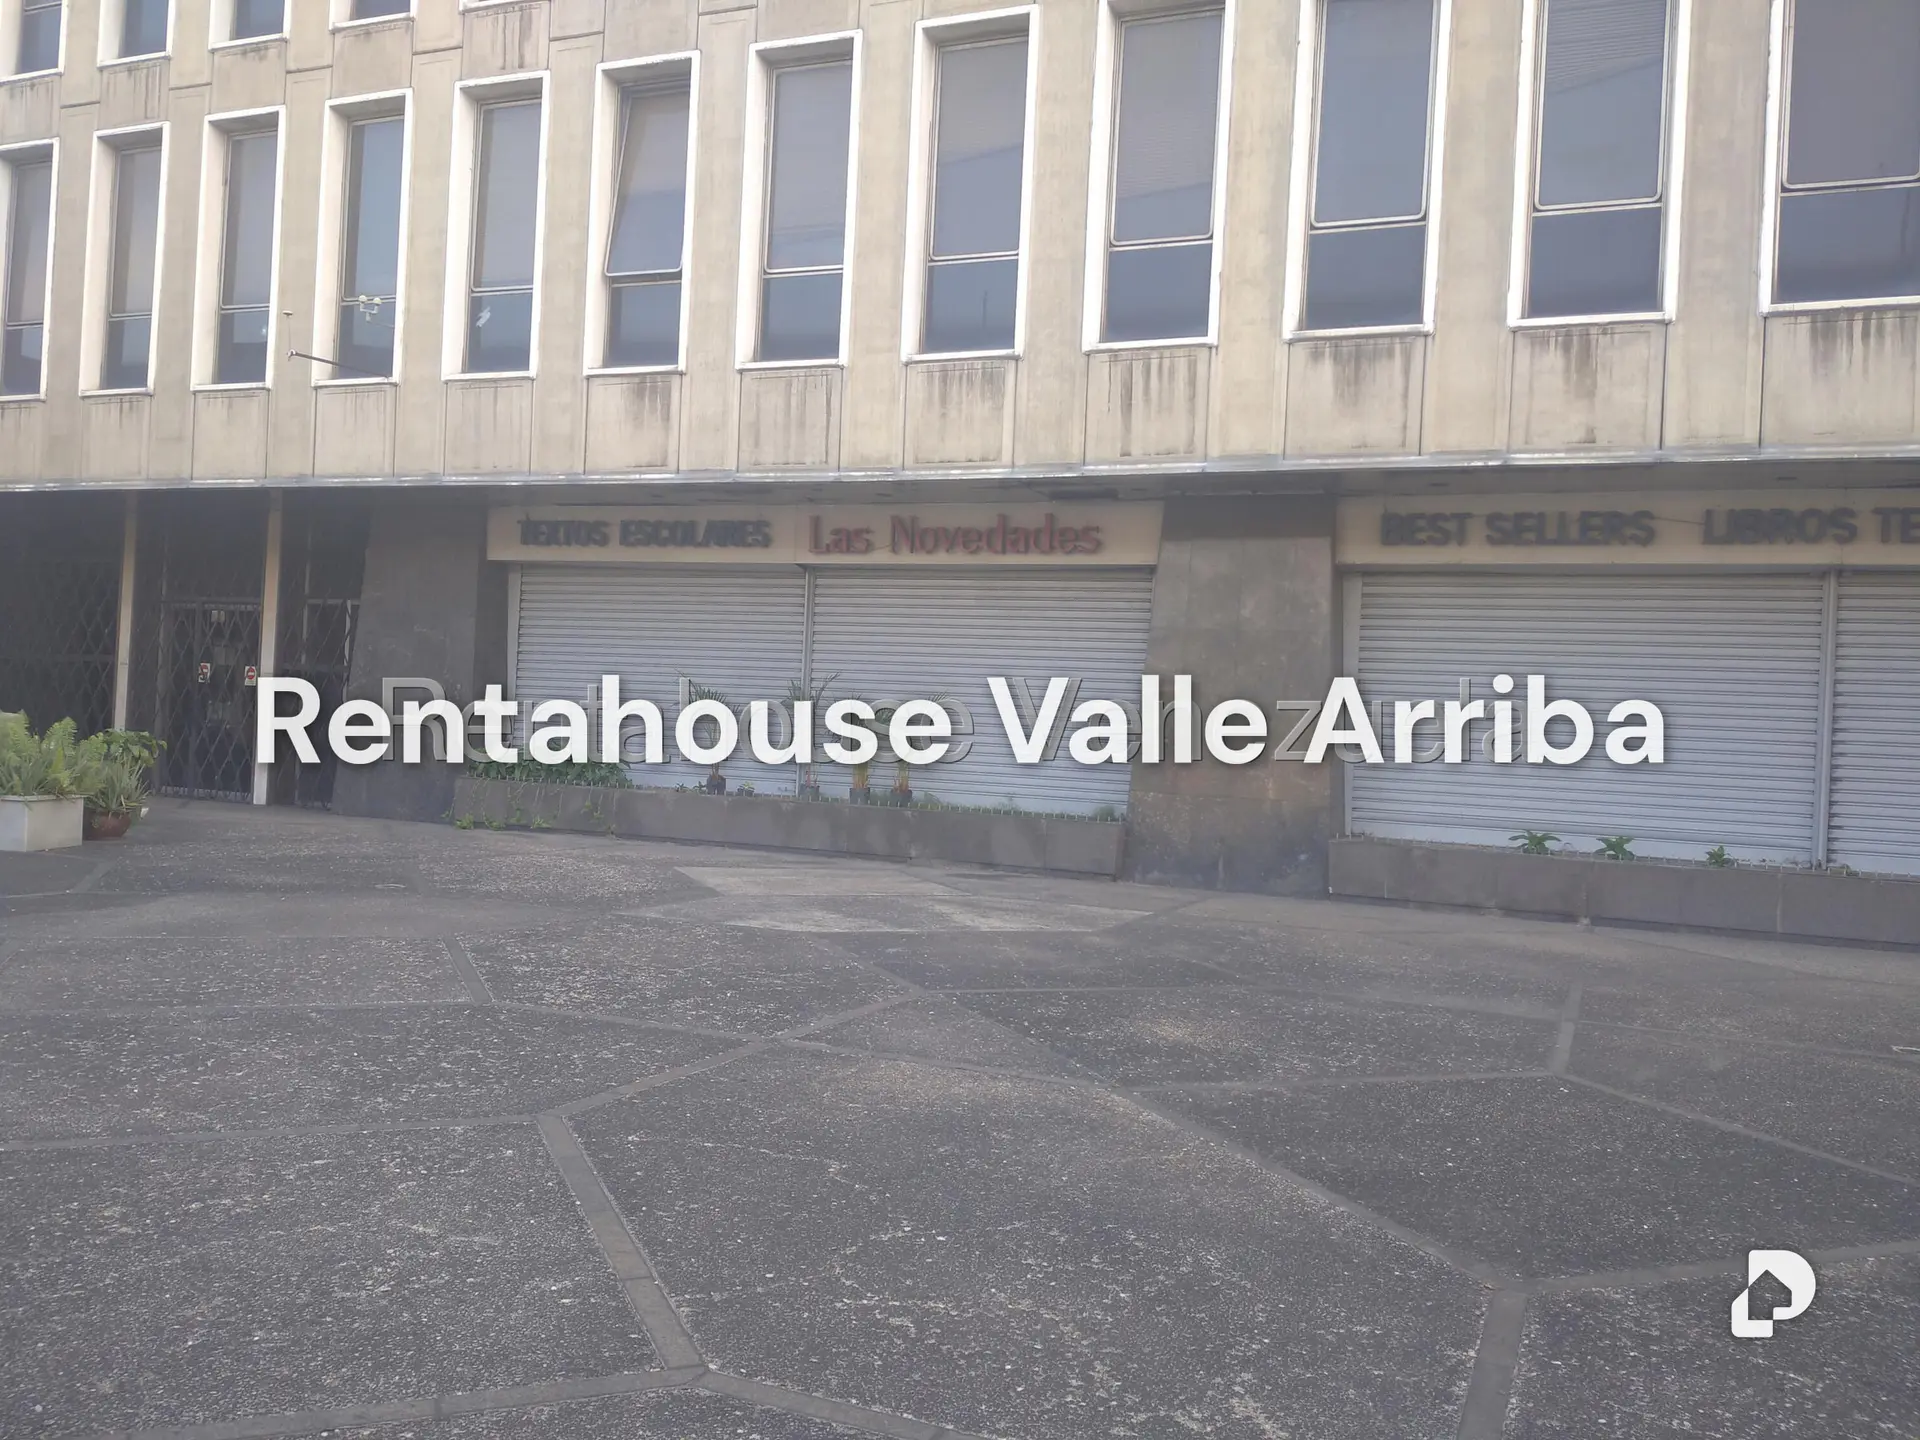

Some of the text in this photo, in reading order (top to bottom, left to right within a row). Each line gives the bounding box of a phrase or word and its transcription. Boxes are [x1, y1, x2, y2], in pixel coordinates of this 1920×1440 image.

[619, 519, 772, 547] ESCOLARES
[808, 512, 1103, 555] Las Novedades
[1381, 510, 1656, 547] BEST SELLERS
[1702, 507, 1858, 545] LIBROS
